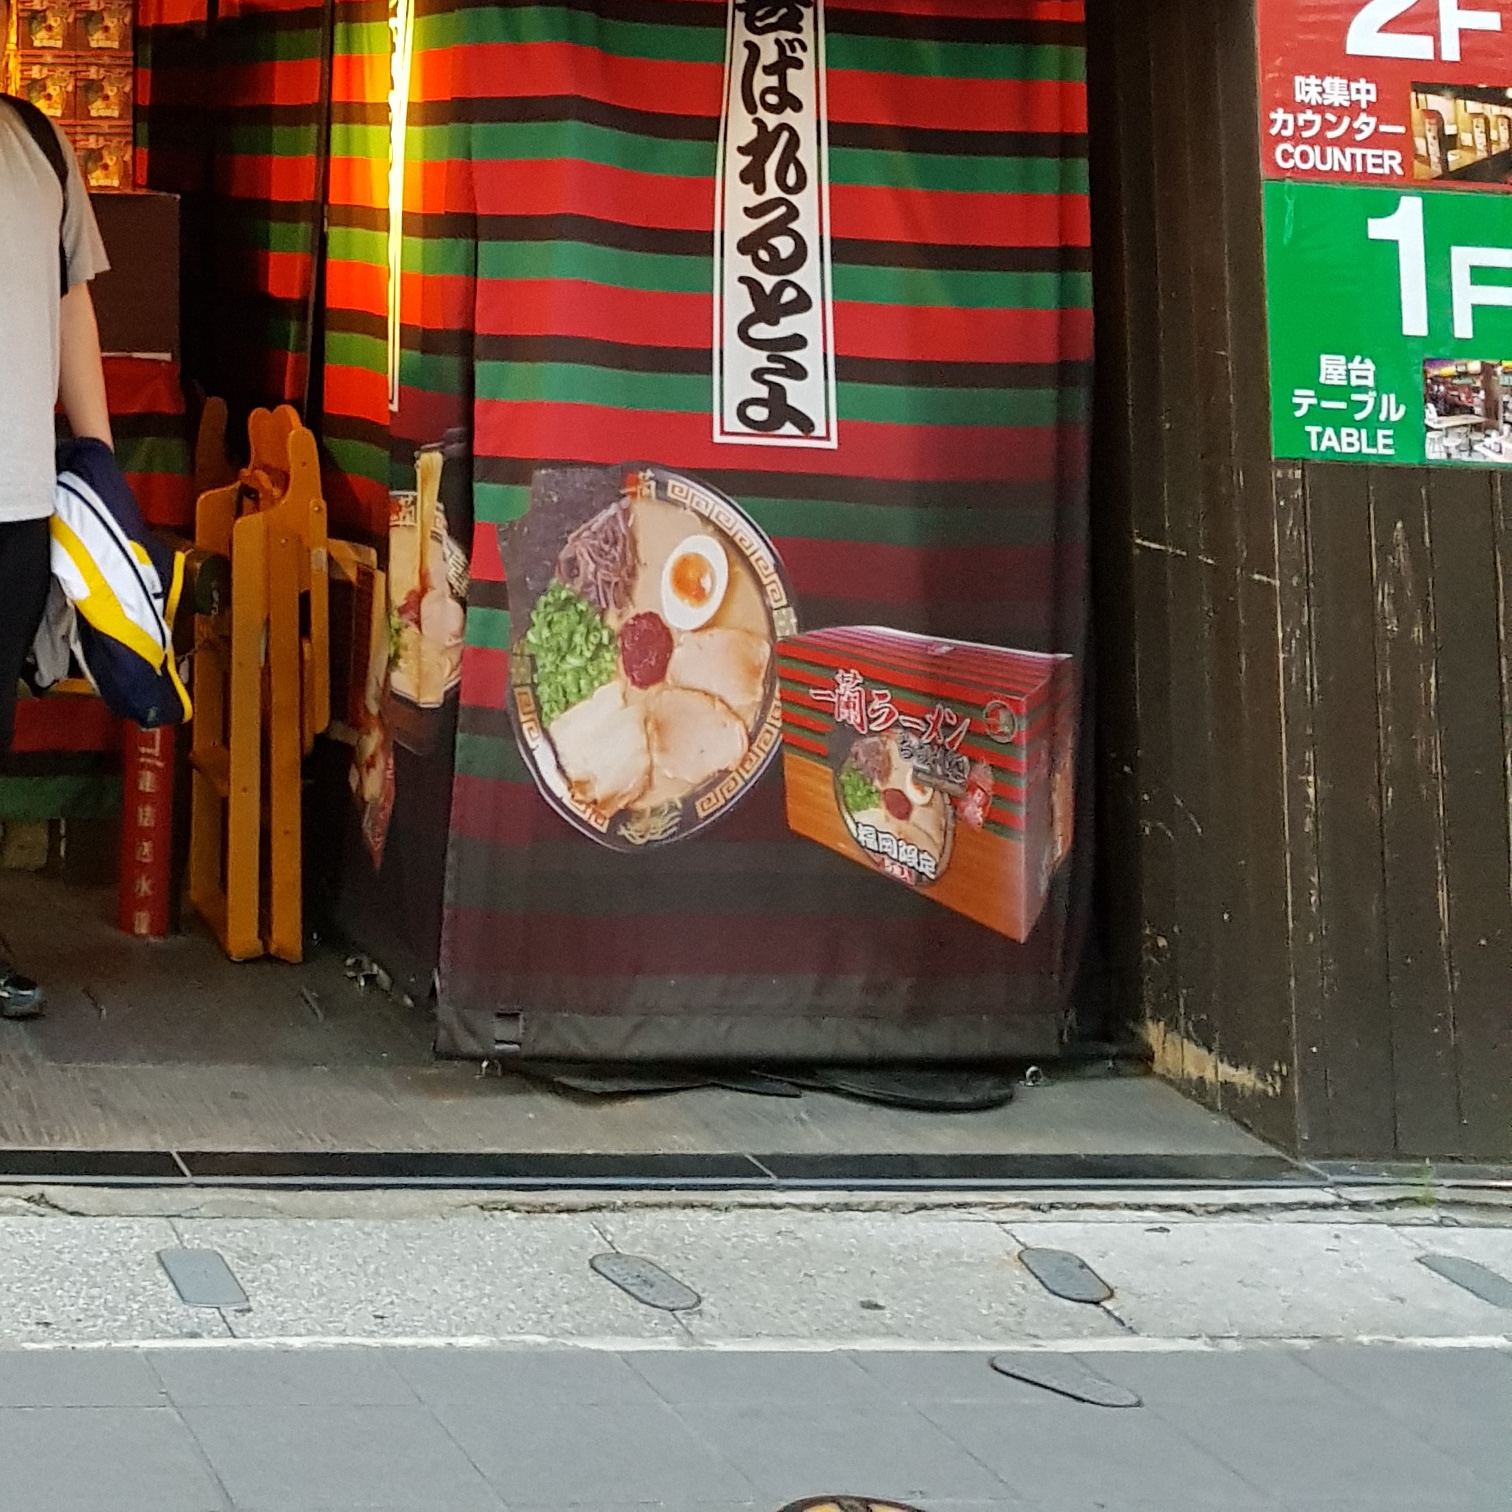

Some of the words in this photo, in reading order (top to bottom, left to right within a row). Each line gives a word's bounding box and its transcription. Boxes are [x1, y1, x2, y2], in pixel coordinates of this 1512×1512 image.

[1294, 75, 1377, 108] 味集中
[1268, 108, 1406, 141] カウンター
[1274, 142, 1404, 176] COUNTER
[1366, 195, 1512, 340] 1F
[1318, 353, 1376, 388] 屋台
[1291, 388, 1406, 423] テーブル
[1304, 425, 1396, 455] TABLE
[809, 668, 971, 751] 一蘭ラーメン
